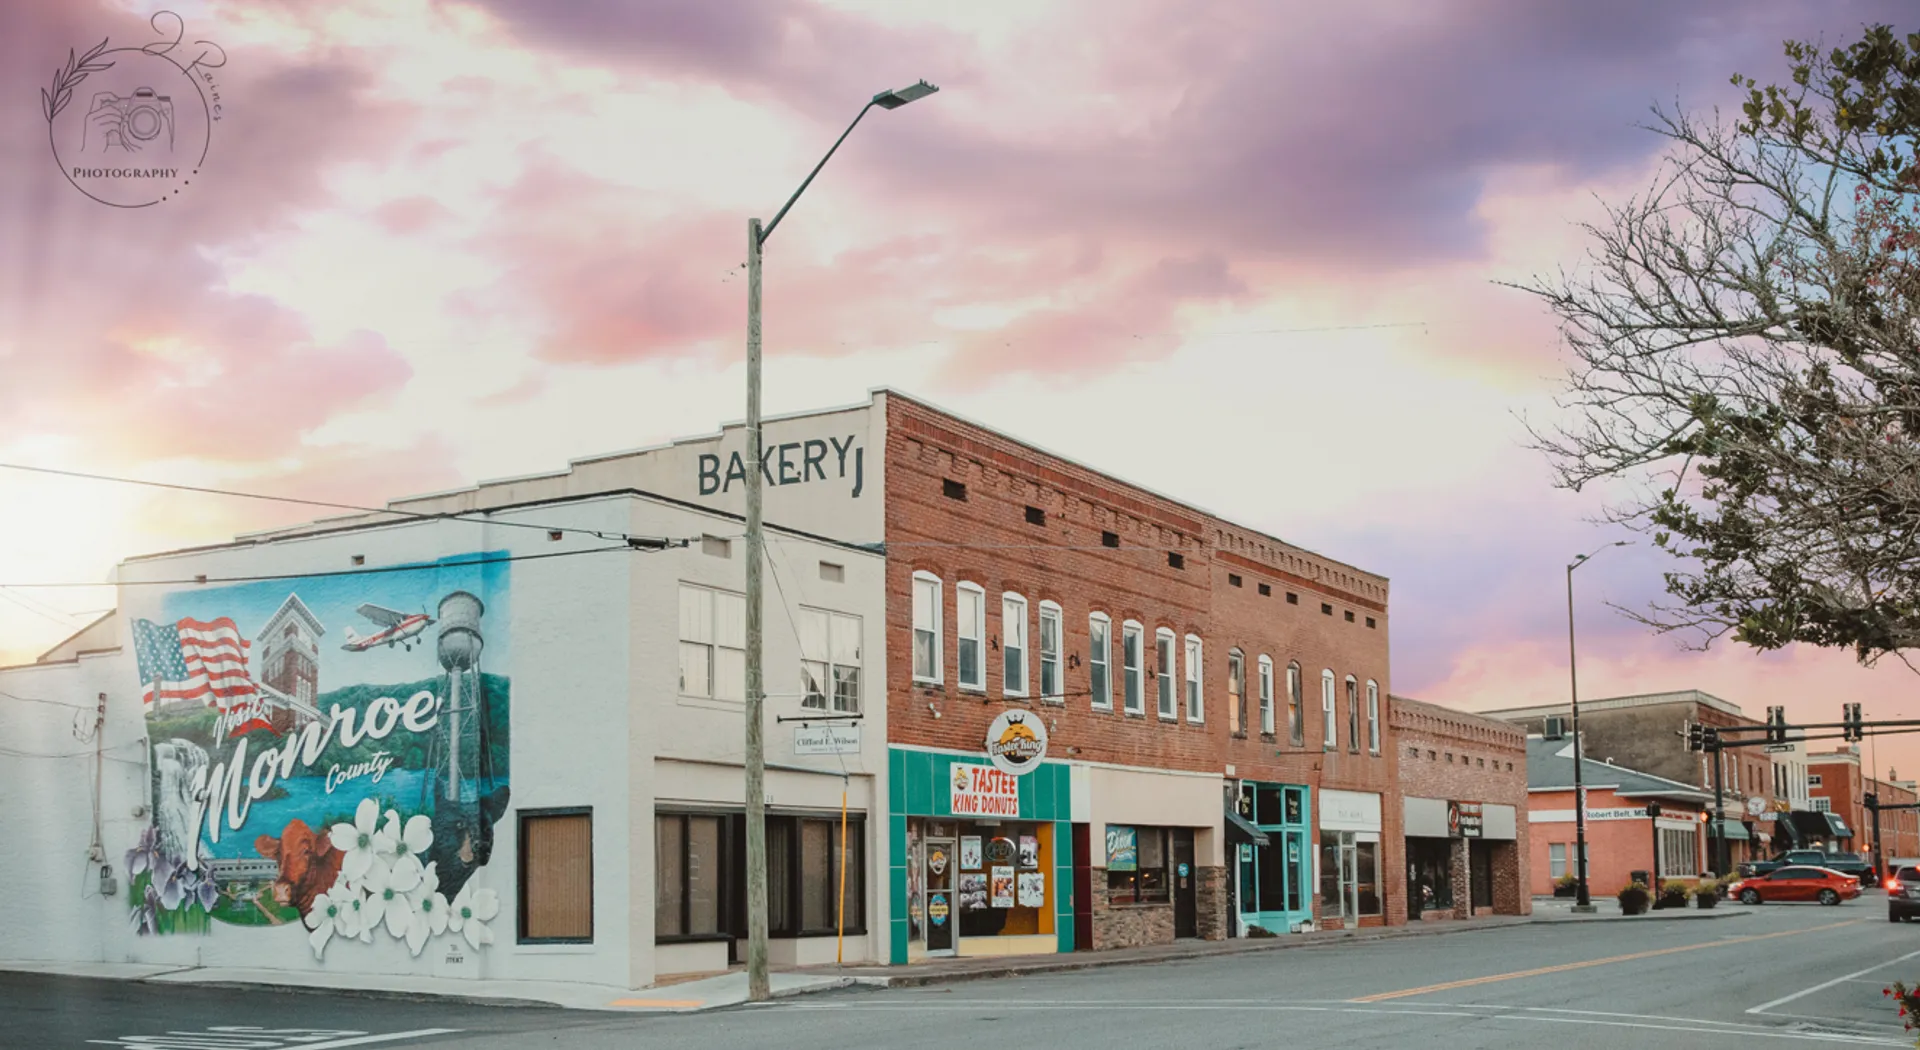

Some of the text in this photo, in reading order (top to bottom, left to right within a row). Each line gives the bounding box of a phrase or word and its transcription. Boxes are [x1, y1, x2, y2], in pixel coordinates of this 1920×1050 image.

[699, 434, 855, 496] BAKERY
[212, 695, 270, 749] Visit
[186, 690, 443, 871] Monroe
[325, 751, 394, 794] County
[972, 767, 1016, 795] TASTEE
[953, 793, 1017, 815] KING DONUTS
